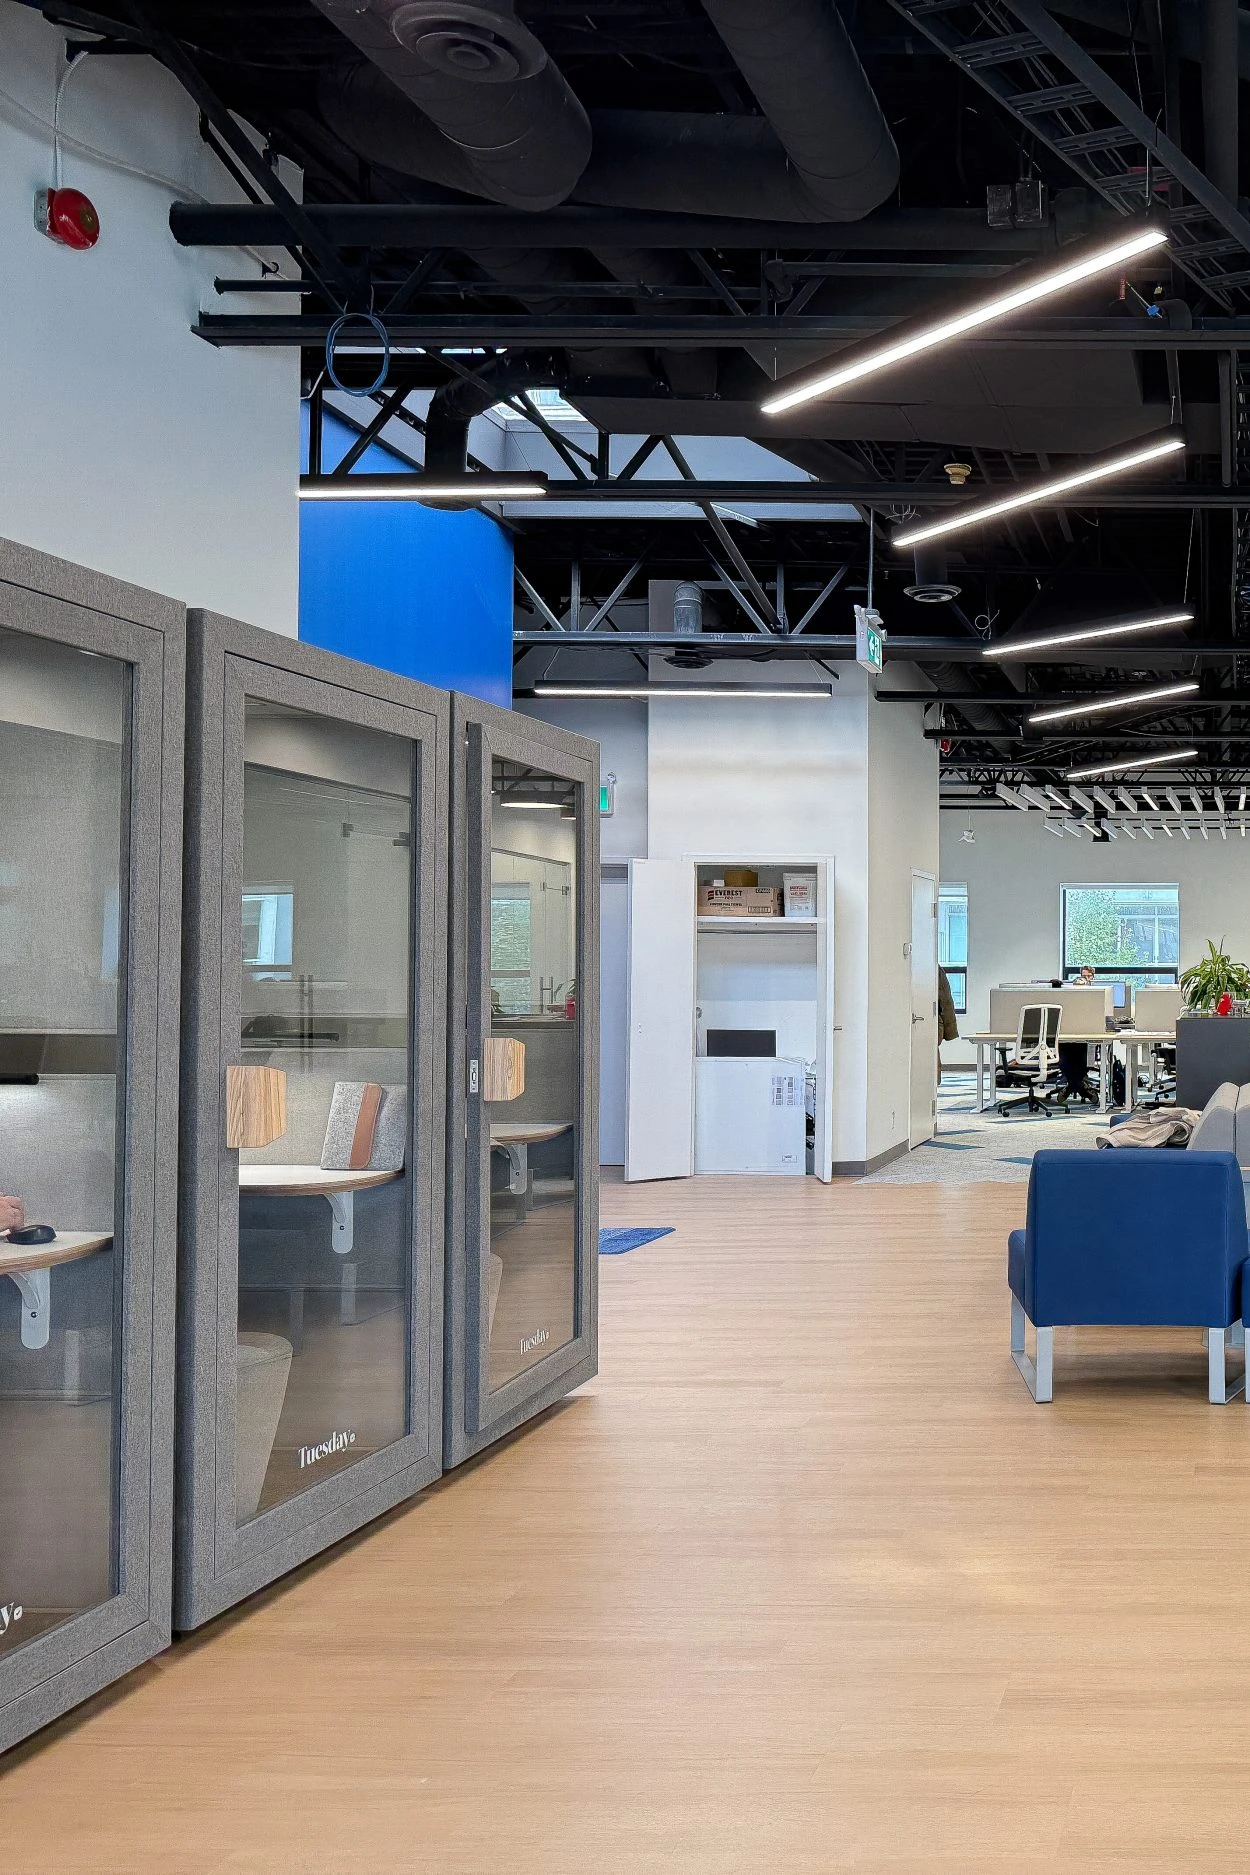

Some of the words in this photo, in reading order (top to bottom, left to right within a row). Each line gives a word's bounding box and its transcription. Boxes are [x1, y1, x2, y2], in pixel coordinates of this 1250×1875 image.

[715, 889, 743, 897] EVEREST
[519, 1329, 548, 1355] Tuesday
[298, 1429, 351, 1469] Tuesday
